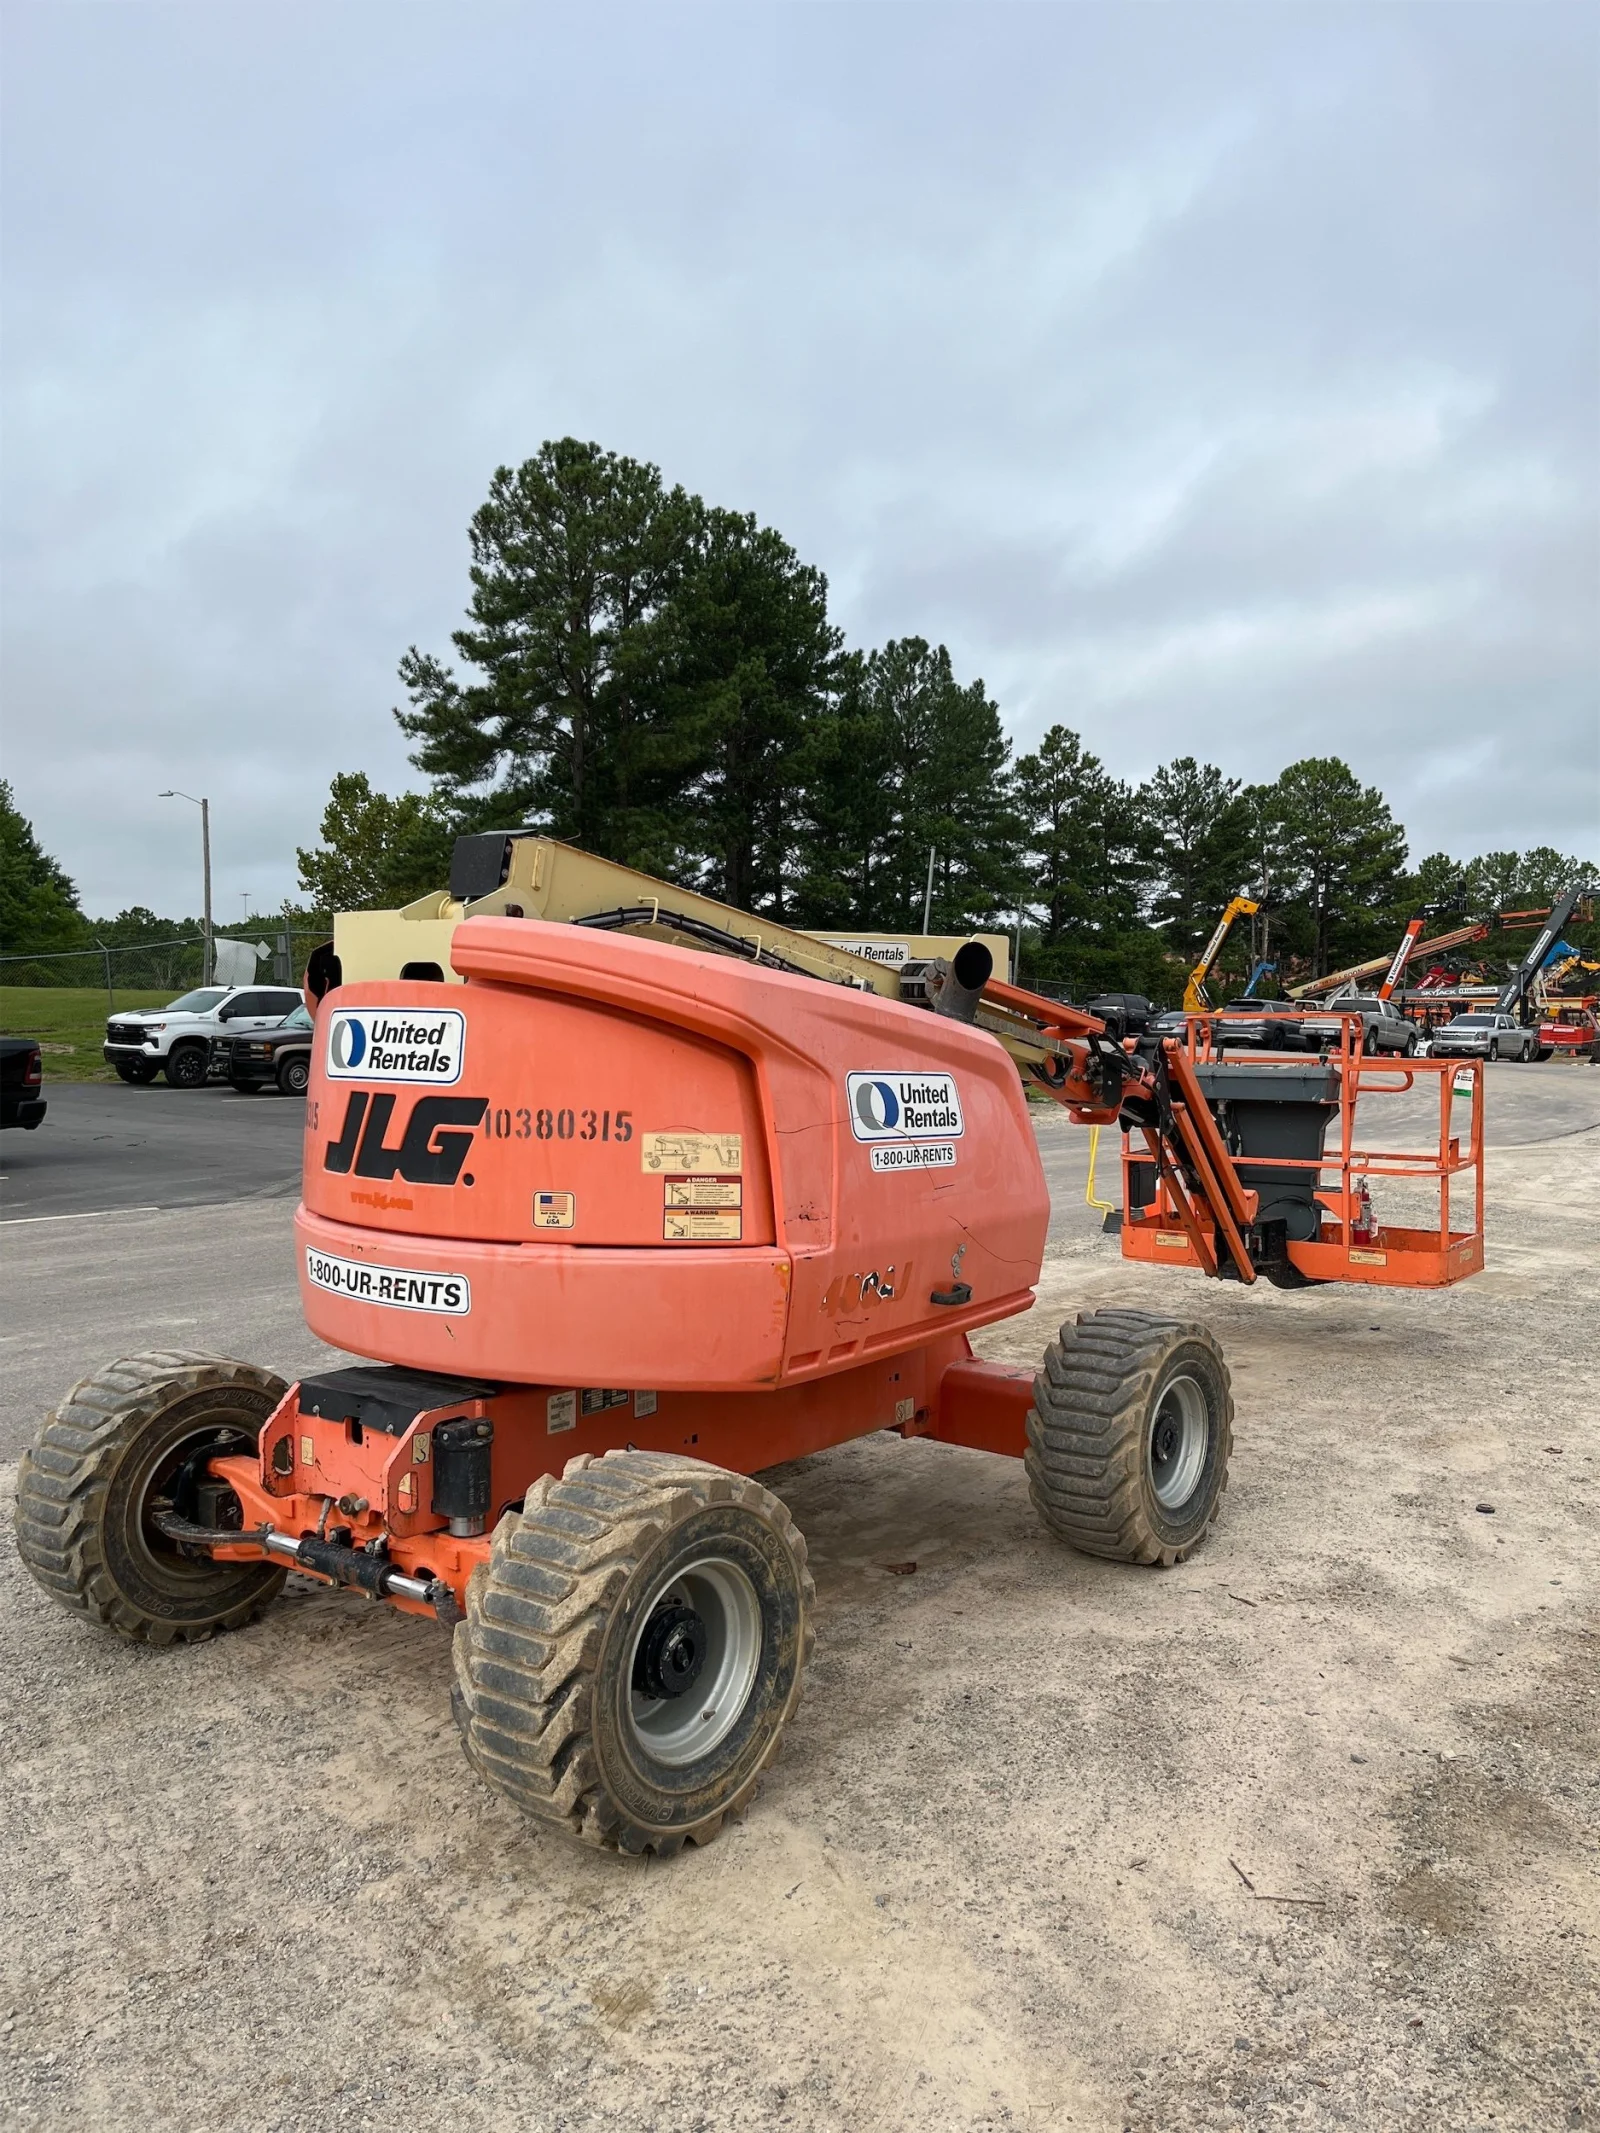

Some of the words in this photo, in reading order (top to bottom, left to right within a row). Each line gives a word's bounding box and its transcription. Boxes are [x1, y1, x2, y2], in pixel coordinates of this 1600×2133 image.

[864, 947, 904, 961] Rentals
[371, 1020, 446, 1045] United
[368, 1046, 451, 1073] Rentals
[900, 1083, 949, 1104] United
[485, 1108, 633, 1142] 10380315
[904, 1106, 958, 1128] Rentals
[874, 1146, 954, 1167] 1-800-UR-RENTS
[309, 1255, 462, 1308] 1-800-UR-RENTS
